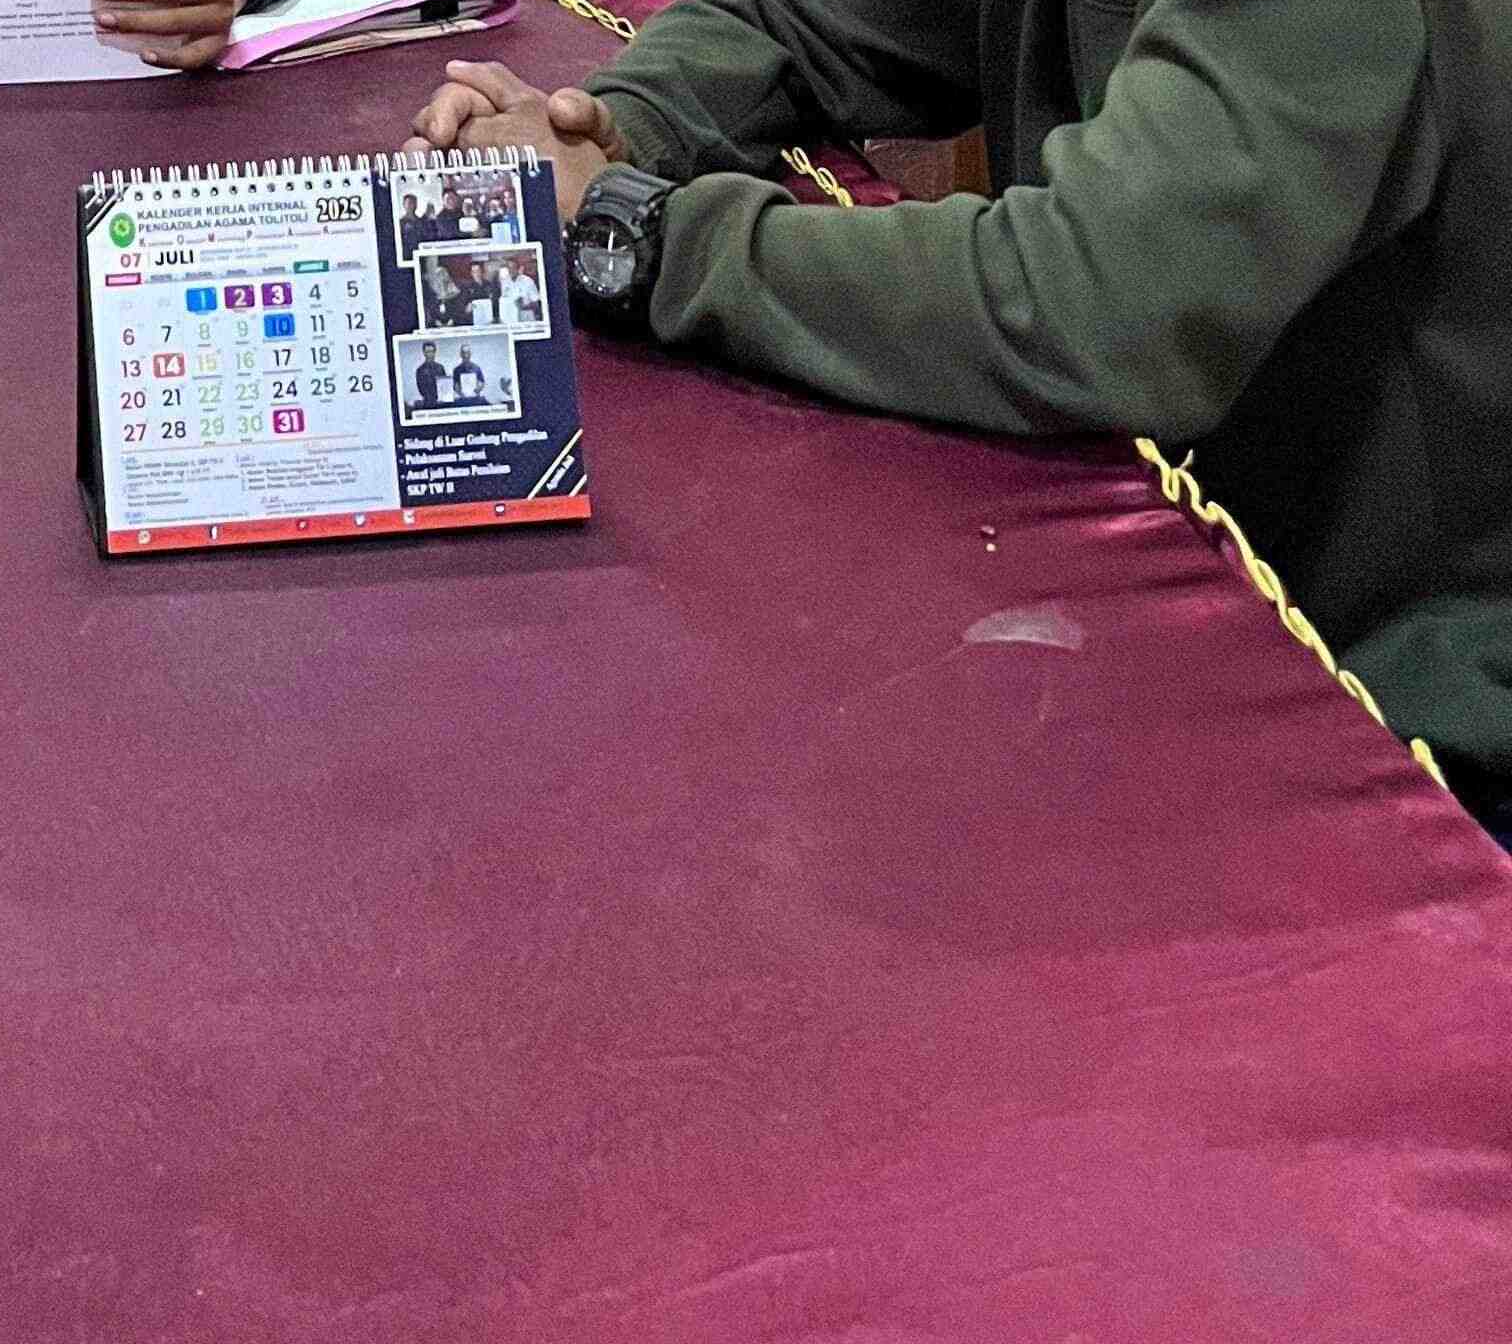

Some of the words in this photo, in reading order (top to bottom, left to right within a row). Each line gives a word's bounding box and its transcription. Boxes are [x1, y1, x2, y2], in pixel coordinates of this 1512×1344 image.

[138, 205, 204, 220] KALENDER
[206, 203, 245, 217] KERJA
[248, 201, 307, 214] INTERNAL
[316, 196, 362, 223] 2025
[138, 219, 211, 233] PENGADILAN
[214, 216, 255, 228] AGAMA
[120, 254, 142, 268] 07
[155, 250, 194, 266] JULI
[234, 289, 246, 305] 2
[271, 285, 284, 305] 3
[309, 284, 322, 300] 4
[346, 281, 359, 298] 5
[123, 328, 135, 345] 6
[161, 326, 172, 343] 7
[199, 323, 210, 340] 8
[238, 320, 249, 337] 9
[272, 319, 291, 335] 10
[312, 315, 325, 332] 11
[346, 313, 366, 330] 12
[121, 360, 141, 378] 13
[156, 356, 181, 376] 14
[199, 354, 217, 372] 15
[237, 351, 255, 369] 16
[273, 349, 292, 366] 17
[312, 347, 331, 364] 18
[348, 344, 369, 361] 19
[121, 391, 146, 409] 20
[162, 388, 181, 406] 21
[198, 385, 221, 403] 22
[236, 383, 259, 401] 23
[272, 381, 298, 399] 24
[311, 378, 336, 395] 25
[348, 375, 373, 393] 26
[123, 424, 146, 442] 27
[161, 421, 186, 439] 28
[200, 419, 224, 437] 29
[238, 415, 263, 434] 30
[278, 412, 300, 432] 31
